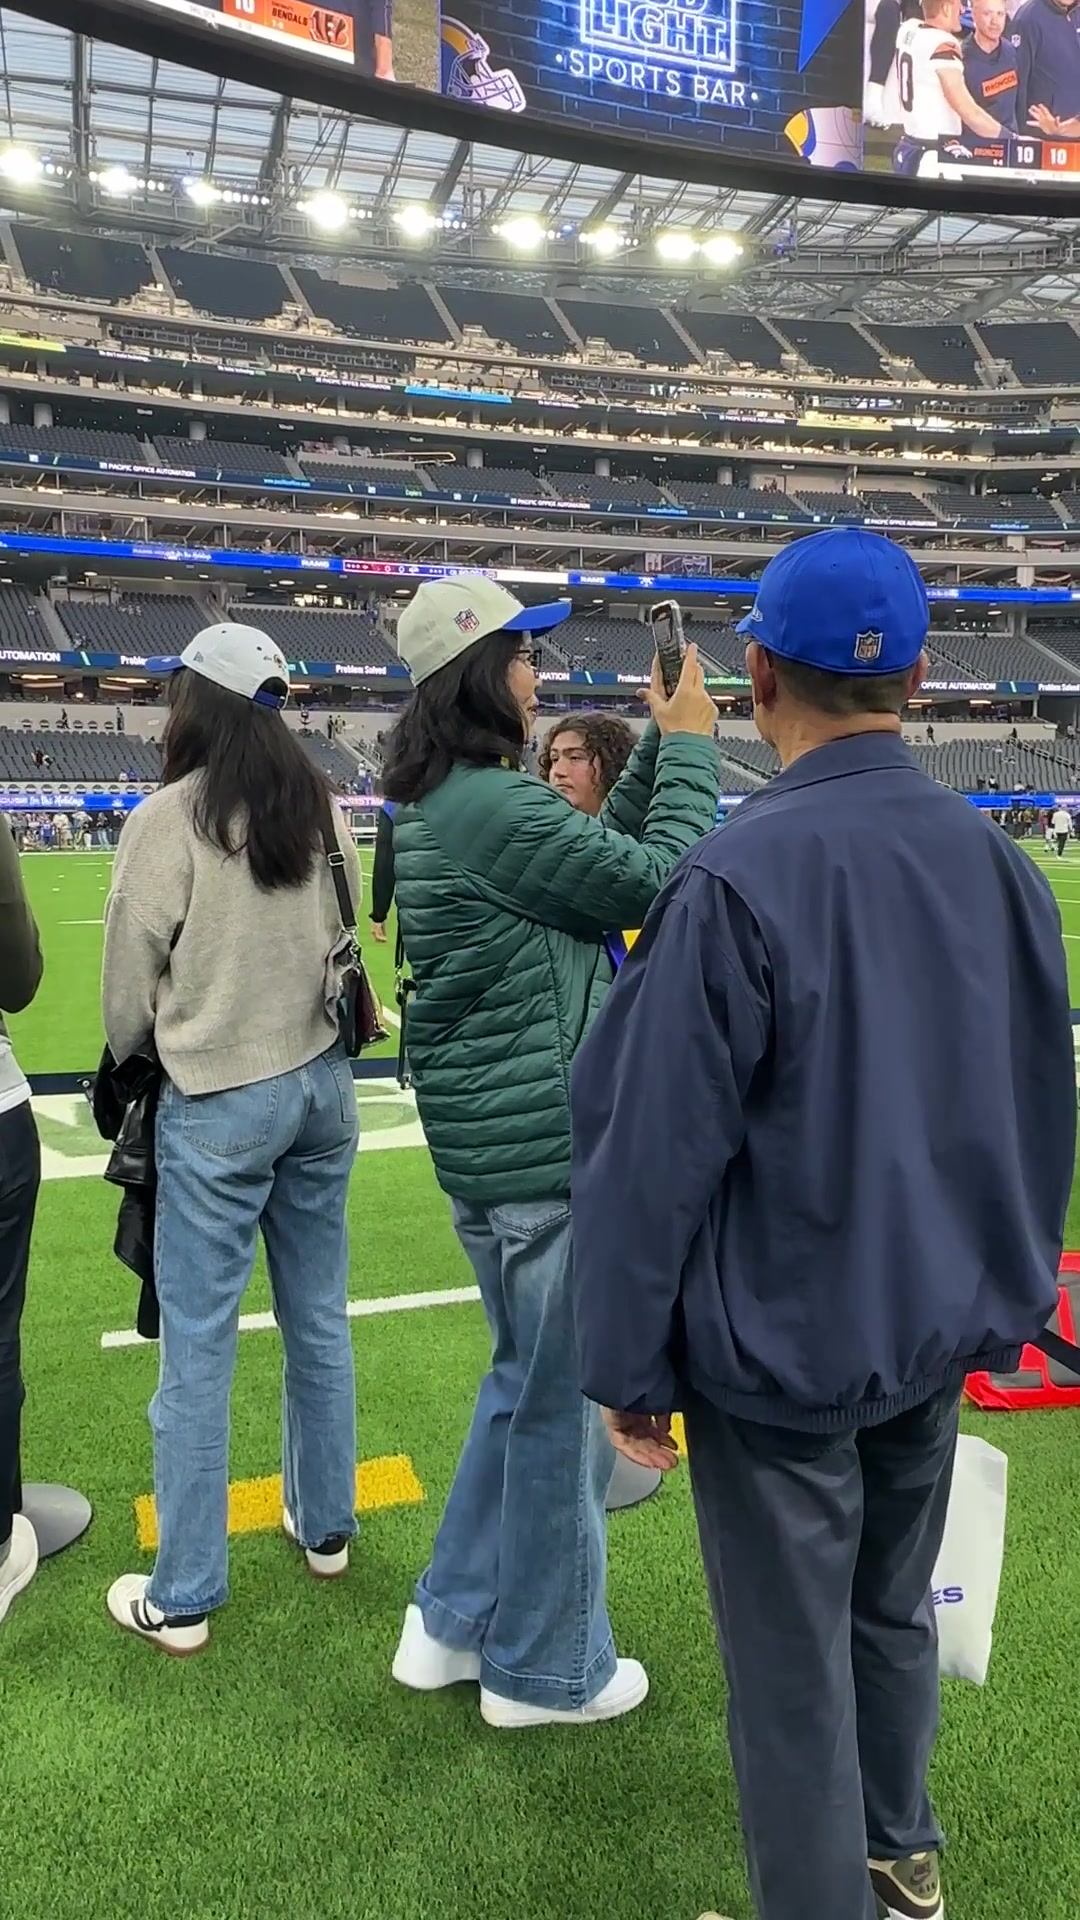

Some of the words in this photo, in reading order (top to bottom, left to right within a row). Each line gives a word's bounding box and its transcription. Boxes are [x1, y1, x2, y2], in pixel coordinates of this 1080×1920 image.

[569, 49, 681, 95] SPORTS
[693, 74, 745, 107] BAR
[1017, 146, 1034, 163] 10
[1050, 148, 1067, 165] 10
[108, 463, 132, 472] PACIFIC
[133, 465, 155, 474] OFFICE
[156, 467, 196, 478] AUTOMATION
[301, 559, 330, 568] RAMS
[580, 576, 605, 584] RAMS
[0, 650, 61, 662] UTOMATION
[120, 655, 147, 666] Proble
[335, 664, 364, 674] Problem
[364, 665, 387, 675] Solved
[539, 672, 570, 682] MATION
[920, 681, 947, 690] OFFICE
[948, 682, 997, 691] AUTOMATION
